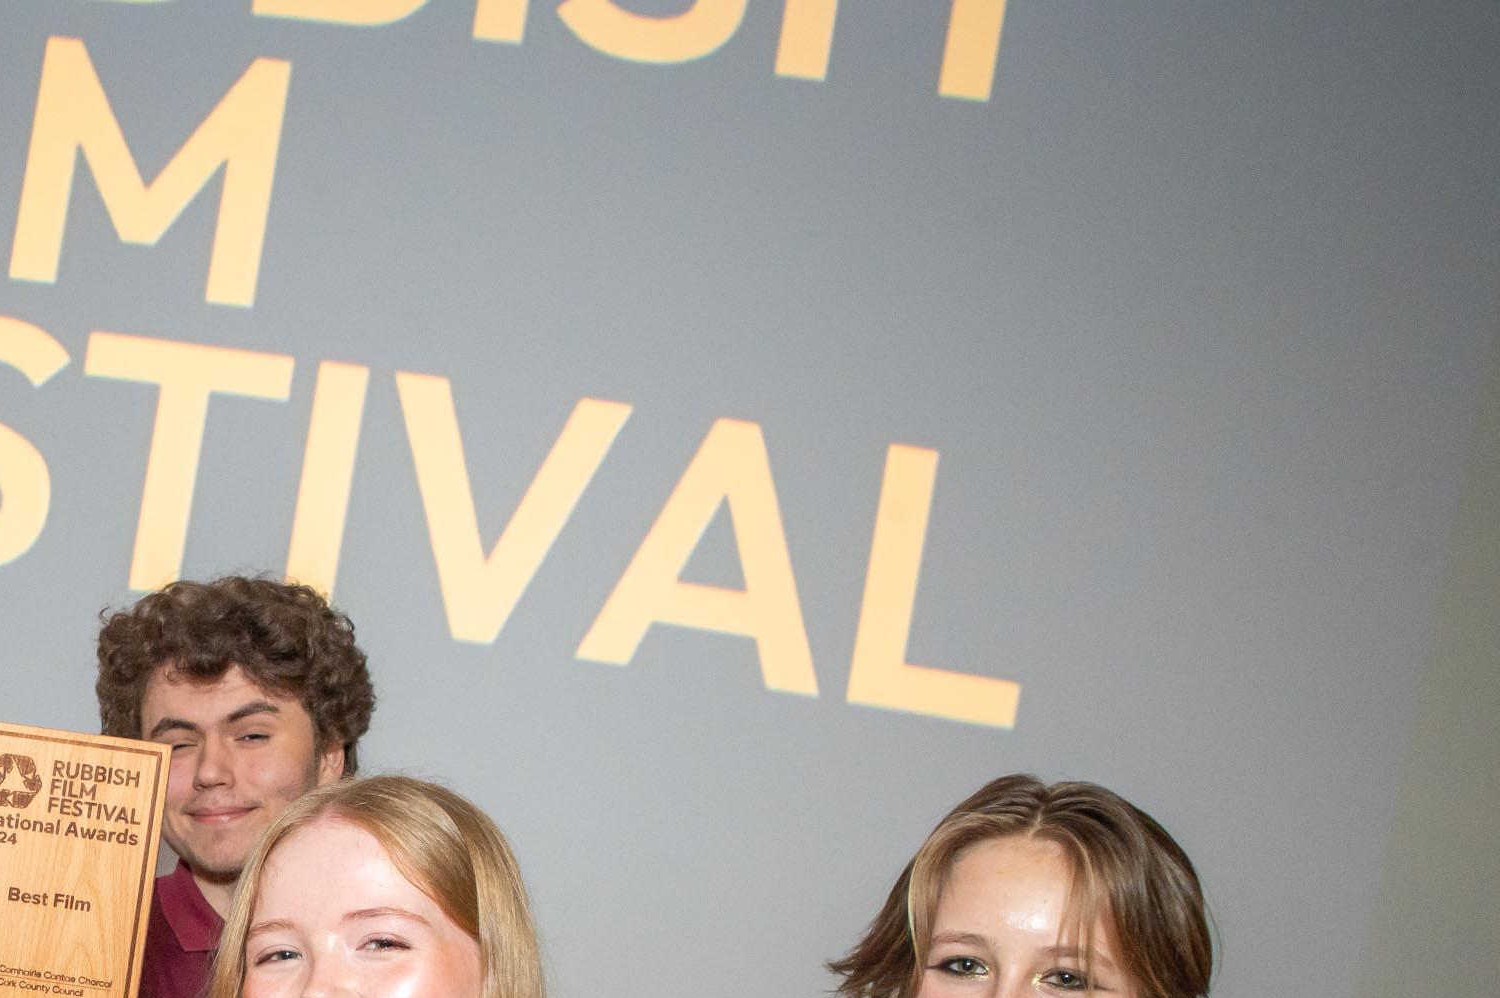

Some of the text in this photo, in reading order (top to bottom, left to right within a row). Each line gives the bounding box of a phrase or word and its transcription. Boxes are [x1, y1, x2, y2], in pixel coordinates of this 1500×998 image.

[52, 760, 140, 788] RUBBISH
[50, 779, 97, 800] FILM
[47, 797, 141, 825] FESTIVAL
[64, 822, 139, 846] Awards
[8, 887, 91, 912] Best Film
[0, 965, 41, 978] Comhairle
[43, 971, 76, 983] Contae
[19, 981, 51, 994] County
[52, 986, 84, 997] Council
